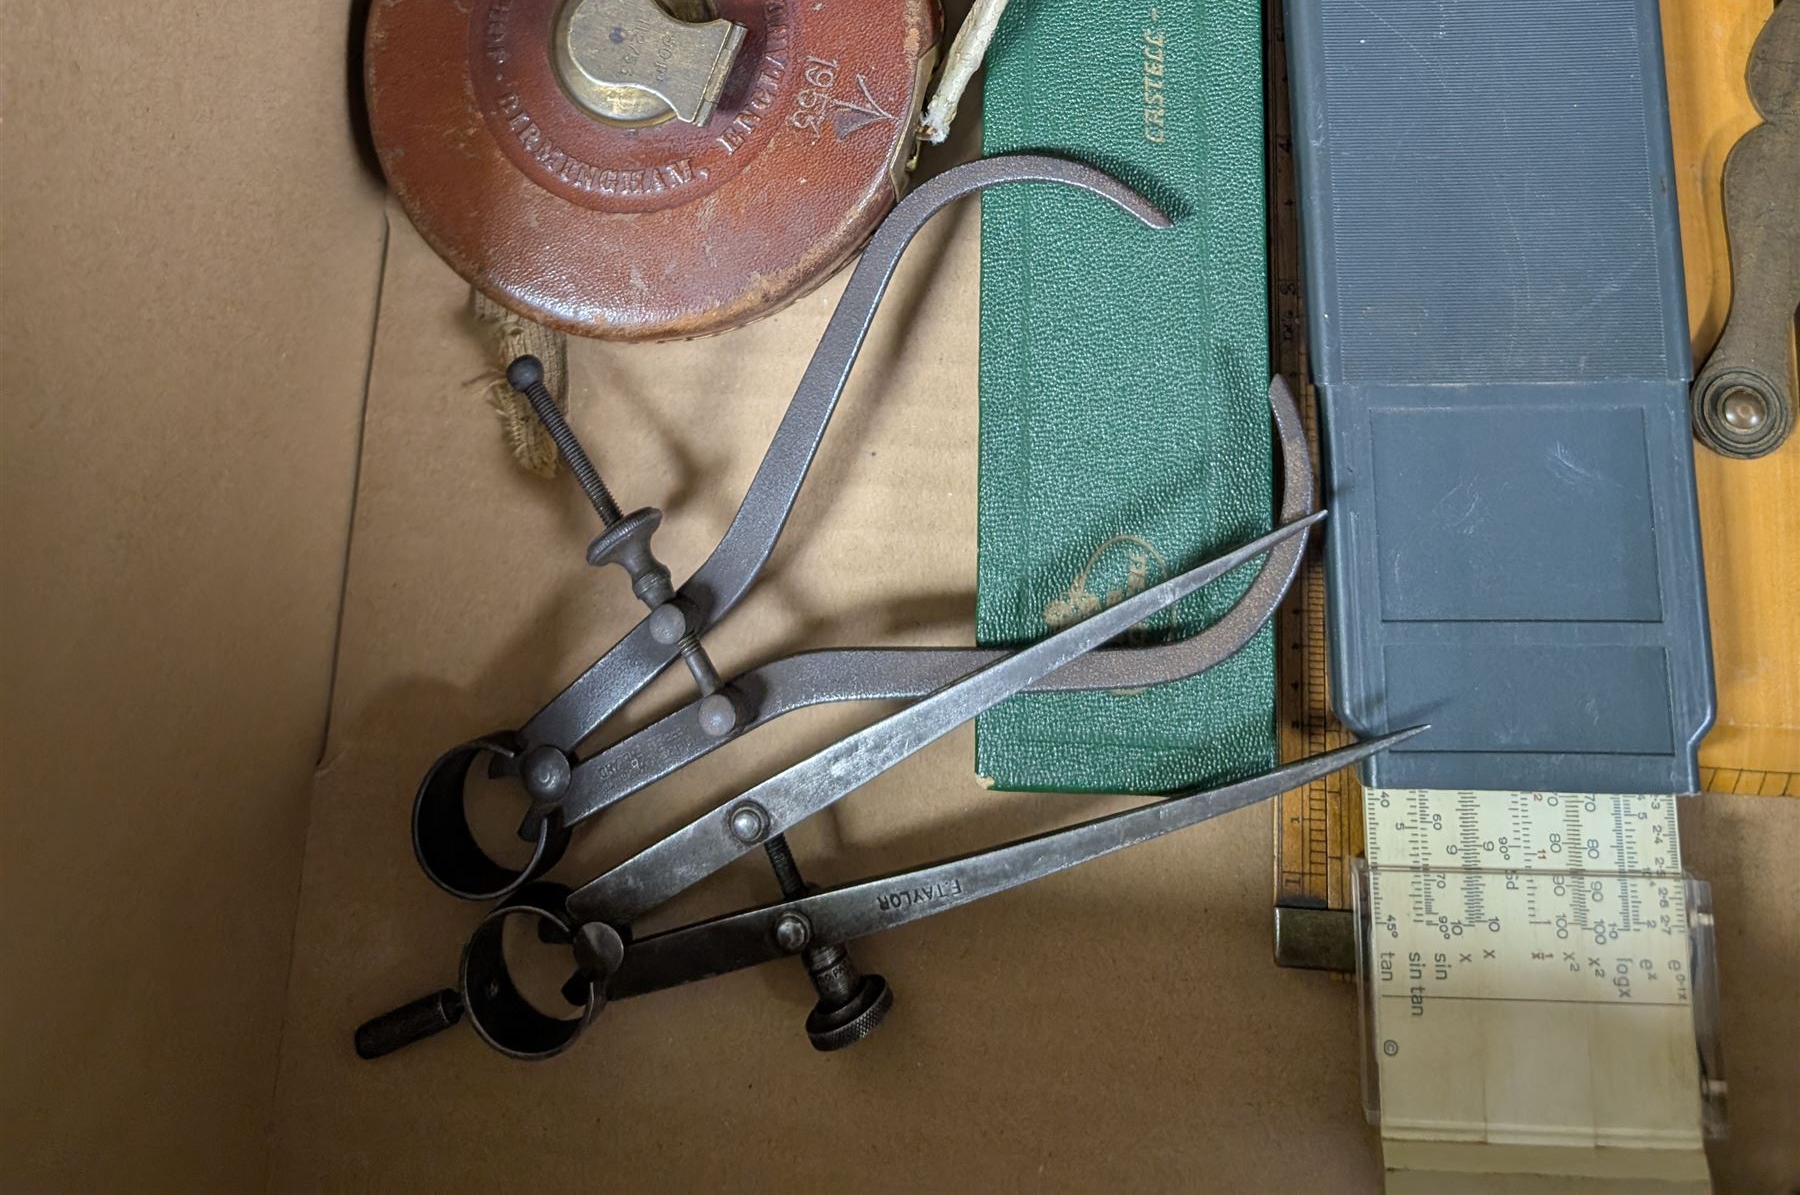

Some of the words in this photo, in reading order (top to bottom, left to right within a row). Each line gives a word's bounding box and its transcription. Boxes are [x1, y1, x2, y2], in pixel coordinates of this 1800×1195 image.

[1144, 30, 1165, 144] CASTELL
[1380, 791, 1390, 808] 40
[1584, 794, 1596, 812] 70
[1433, 814, 1442, 830] 60
[1549, 833, 1561, 853] 80
[1588, 839, 1599, 859] 80
[1436, 873, 1446, 889] 70
[1553, 875, 1566, 897] 90
[1591, 881, 1603, 902] 90
[877, 879, 962, 911] F.TAYLOR
[1556, 914, 1568, 940] 100
[1594, 918, 1607, 945] 100
[1380, 953, 1396, 981] tan
[1409, 952, 1426, 979] sin
[1434, 953, 1451, 980] sin
[1410, 987, 1425, 1017] tan
